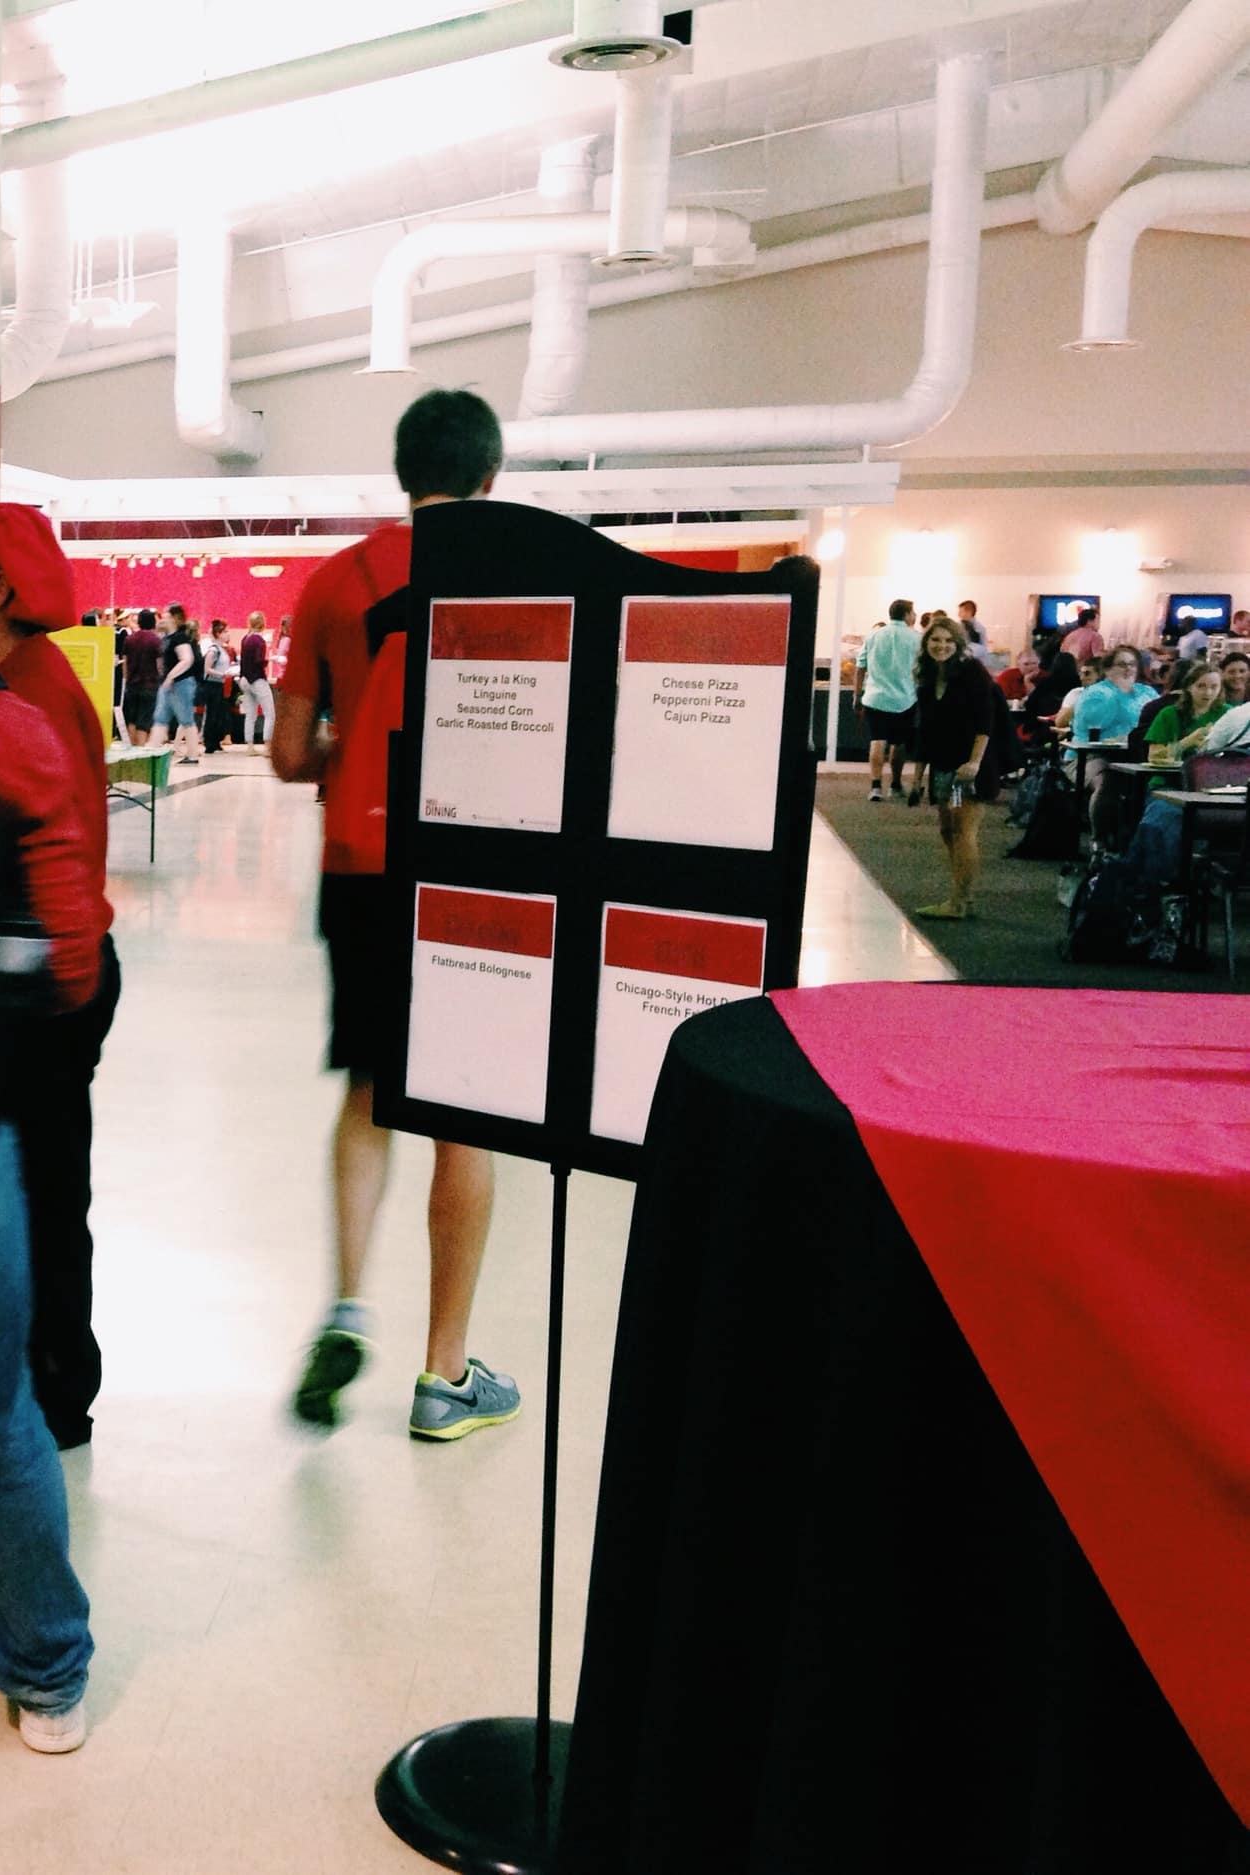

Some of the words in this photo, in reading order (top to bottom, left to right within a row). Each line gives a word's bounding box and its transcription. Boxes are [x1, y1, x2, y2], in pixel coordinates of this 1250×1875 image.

[457, 673, 490, 686] Turkey
[492, 676, 498, 684] a
[501, 674, 510, 685] la
[513, 674, 537, 688] King
[662, 677, 705, 689] Cheese
[708, 679, 739, 691] Pizza
[473, 689, 517, 701] Linguine
[653, 693, 711, 707] Pepperoni
[715, 696, 746, 708] Pizza
[457, 703, 506, 715] Seasoned
[508, 705, 534, 716] Corn
[664, 710, 697, 724] Cajun
[700, 712, 731, 724] Pizza
[436, 717, 464, 728] Garlic
[467, 719, 508, 731] Roasted
[511, 721, 554, 733] Broccoli
[425, 805, 457, 818] DINING
[431, 954, 477, 971] Flatbread
[479, 962, 532, 979] Bolognese
[615, 981, 693, 1004] Chicago-Style
[696, 994, 717, 1007] Hot
[642, 1001, 681, 1017] French
